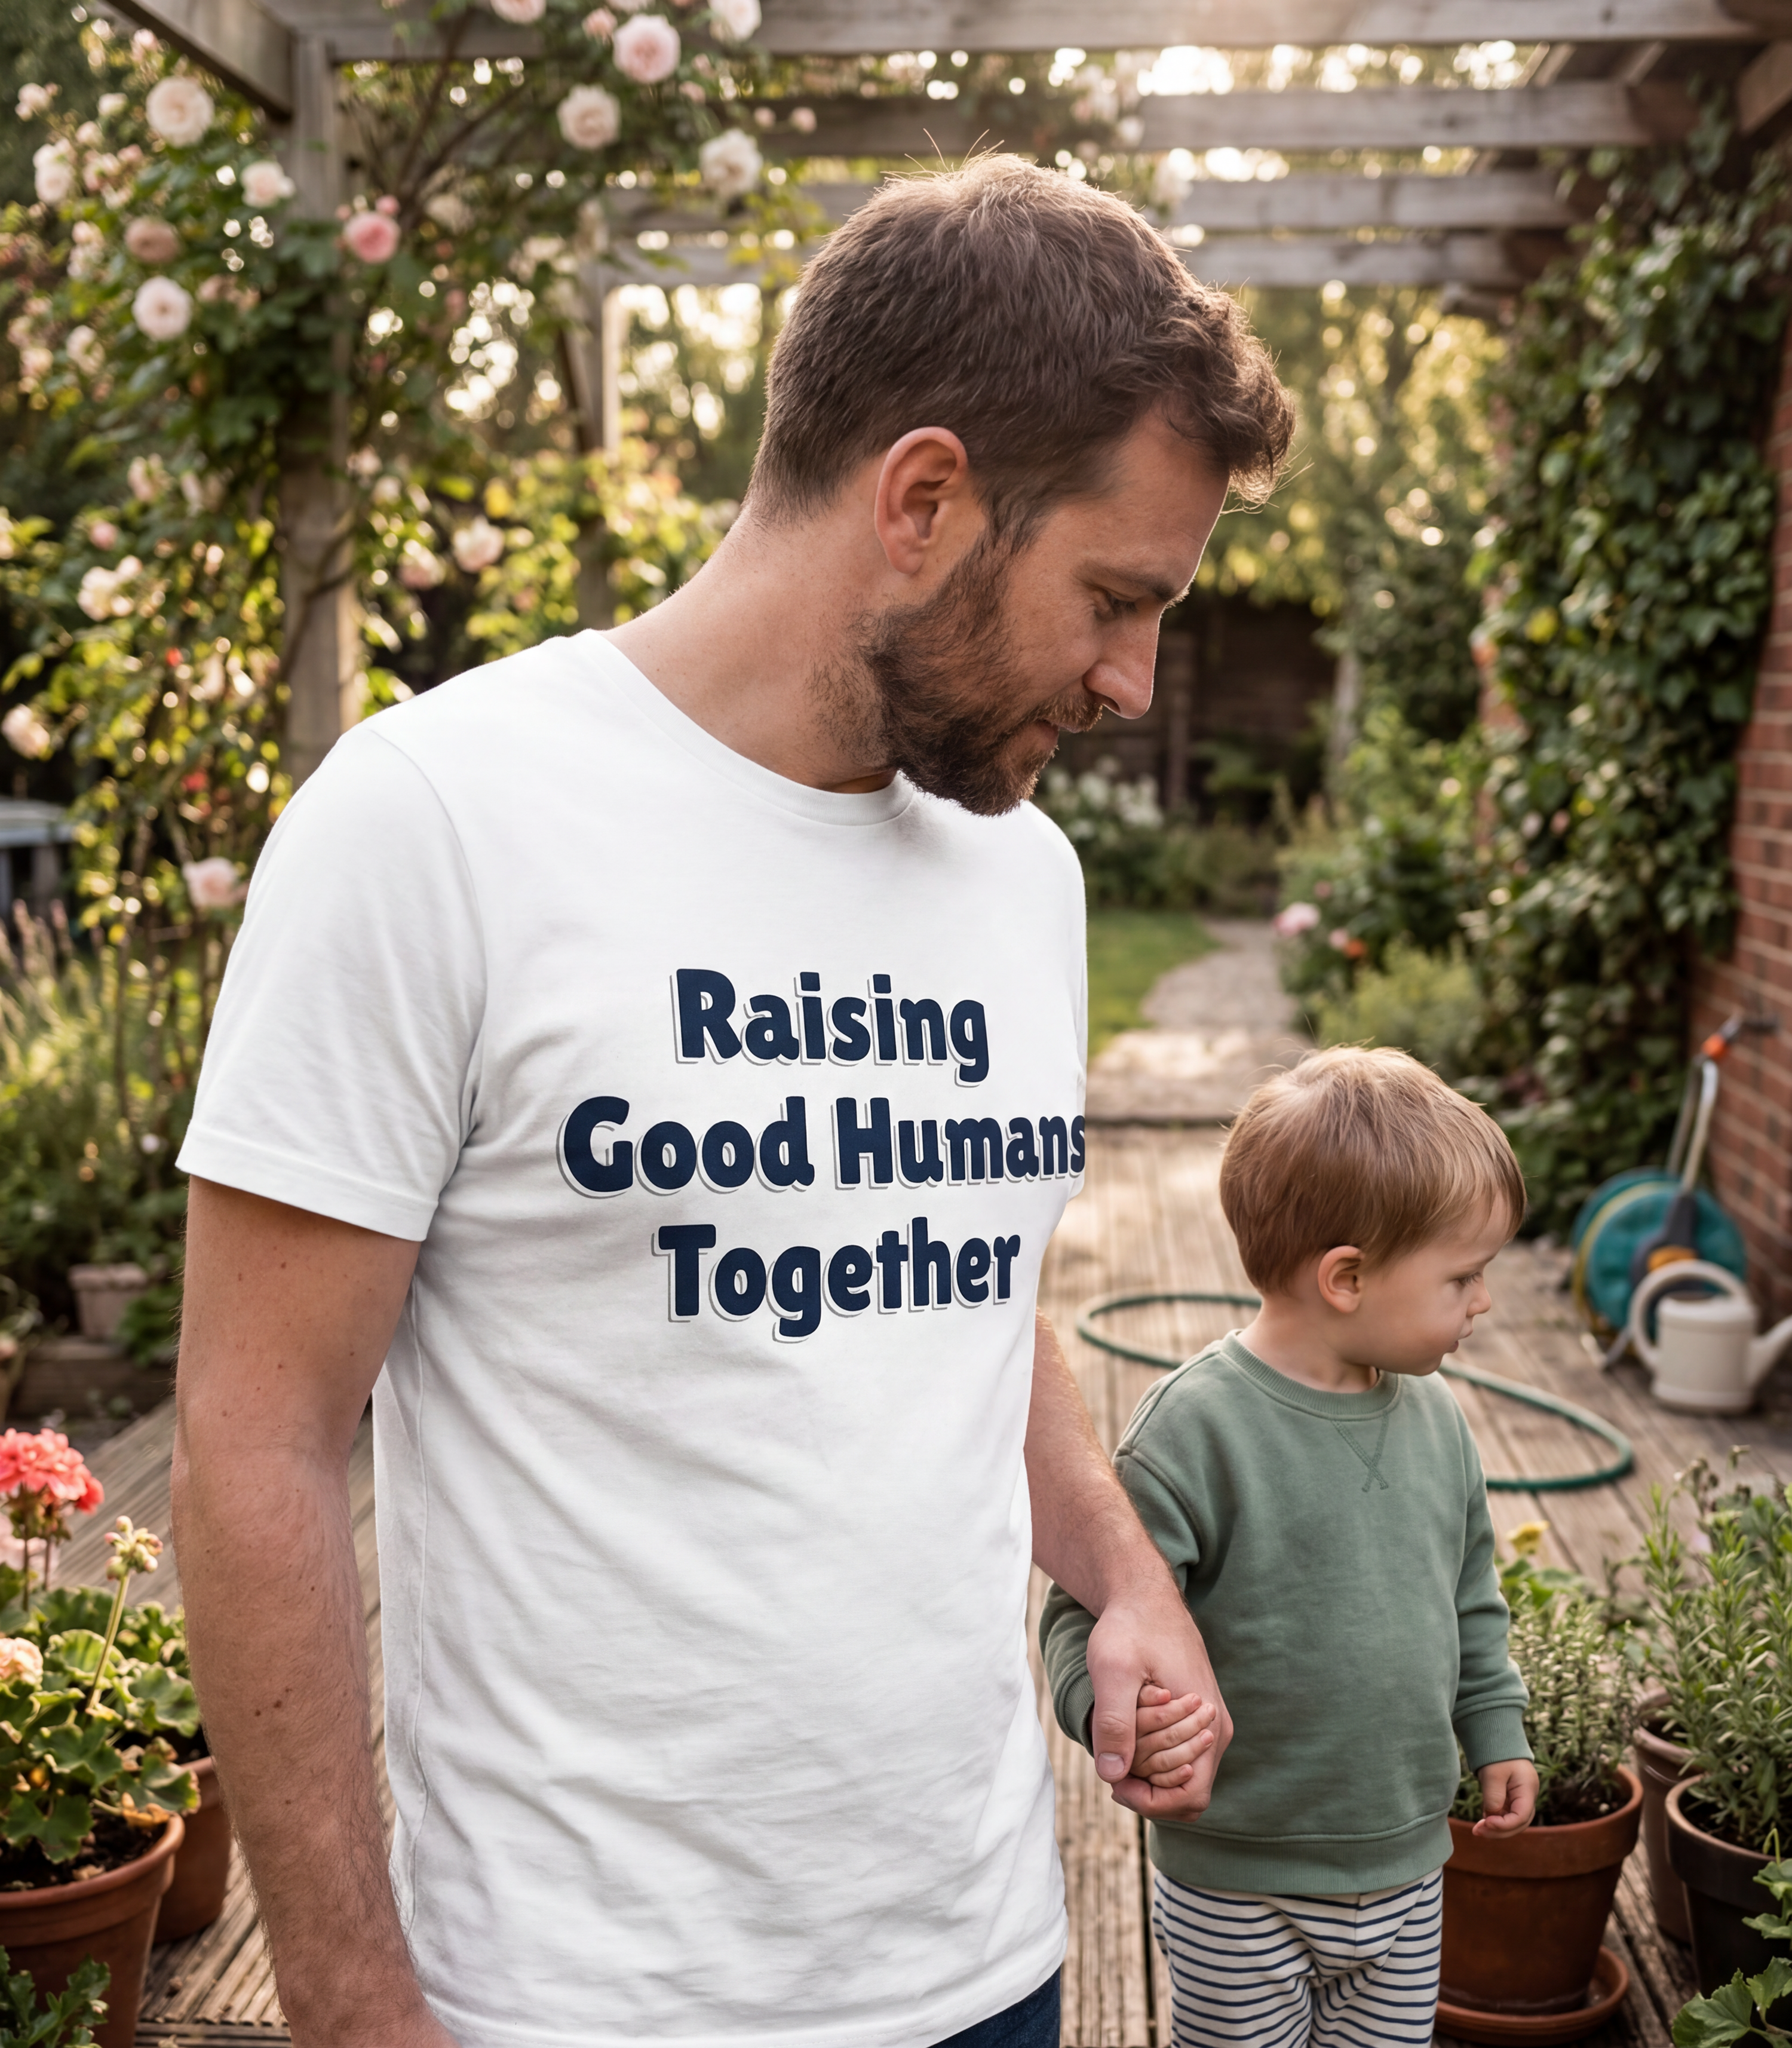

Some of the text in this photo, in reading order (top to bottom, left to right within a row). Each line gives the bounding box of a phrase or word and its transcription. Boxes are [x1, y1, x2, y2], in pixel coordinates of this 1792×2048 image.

[676, 968, 989, 1083] Raising
[563, 1096, 1086, 1192] Good Humans
[658, 1216, 1021, 1337] Together
